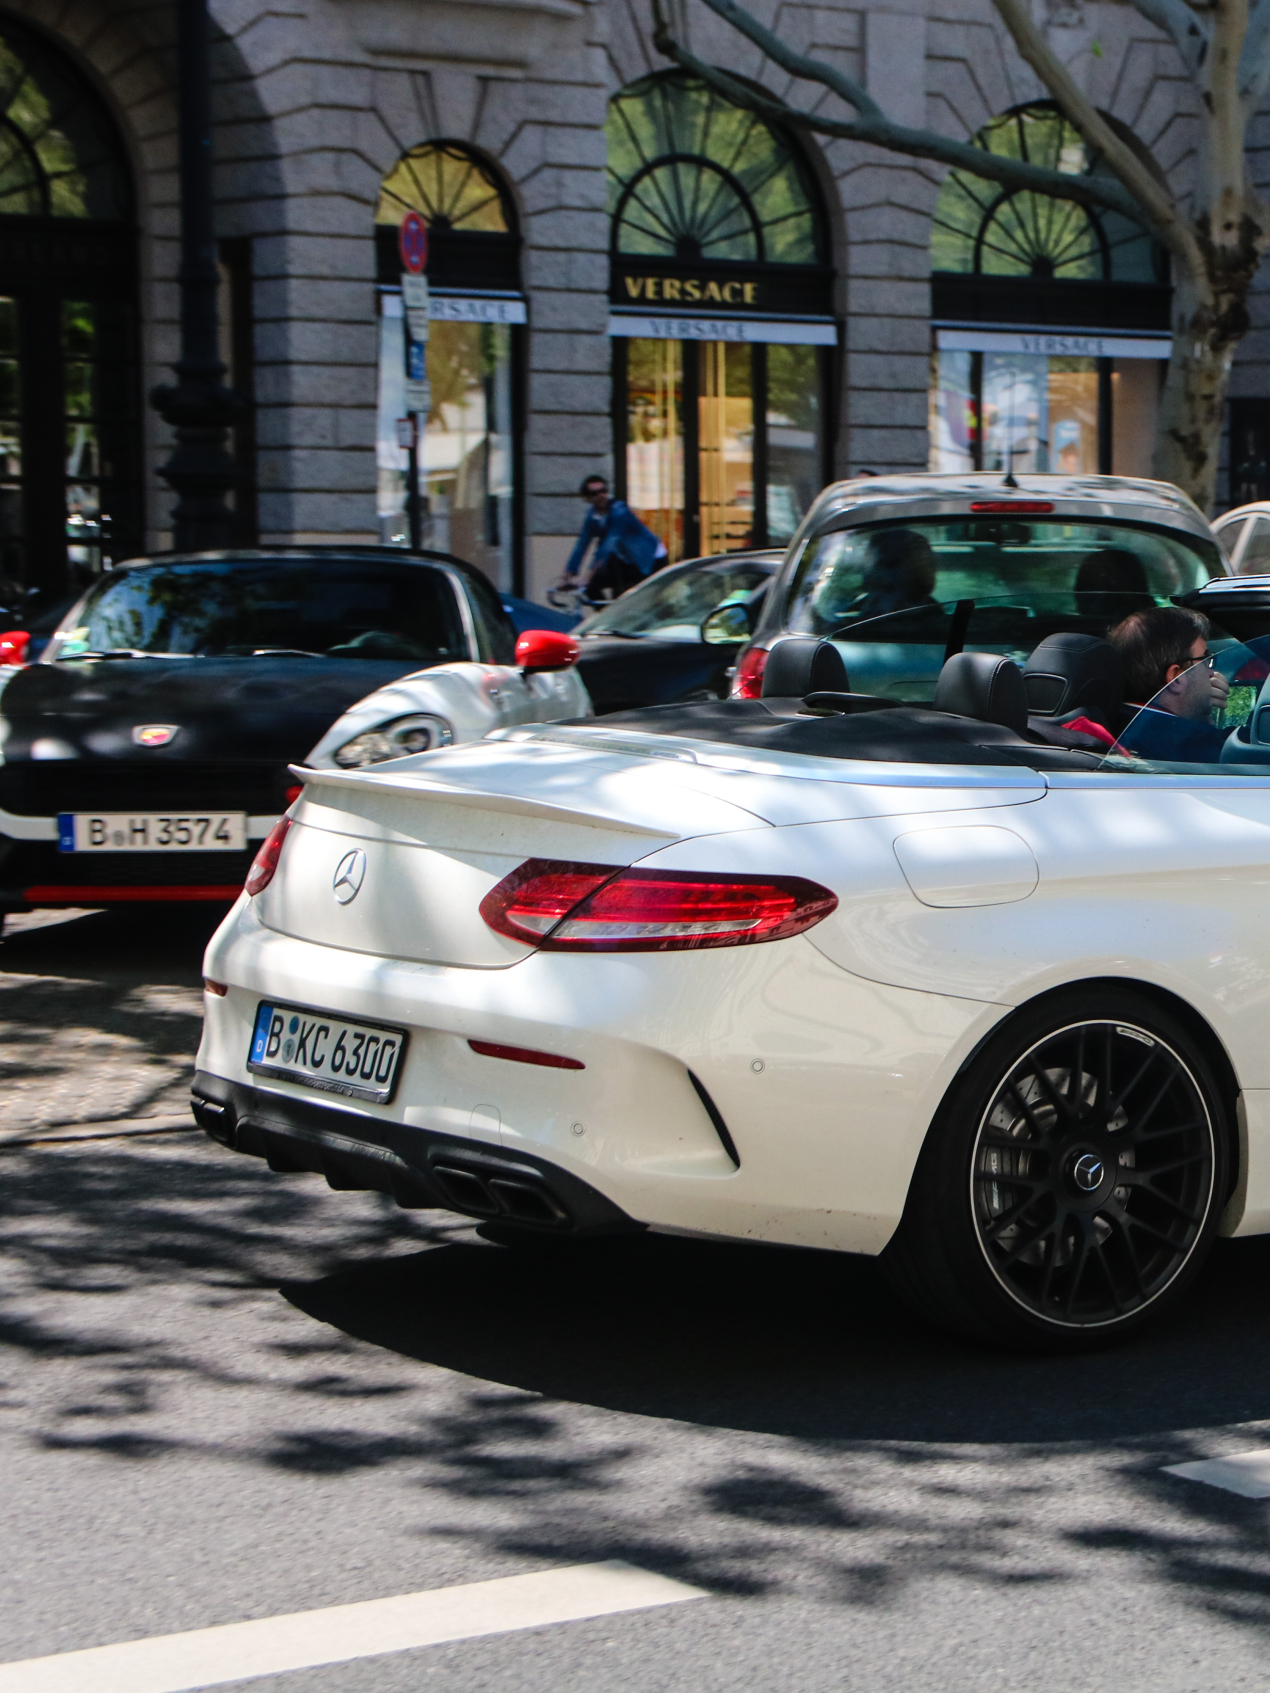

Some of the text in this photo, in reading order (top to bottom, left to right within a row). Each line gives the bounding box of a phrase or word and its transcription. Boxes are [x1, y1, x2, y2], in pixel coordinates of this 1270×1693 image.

[624, 276, 758, 305] VERSACE
[430, 301, 509, 320] RSACE
[650, 319, 746, 340] VERSACE
[1020, 336, 1104, 354] VERSACE
[88, 818, 233, 846] B H 3574
[256, 1040, 264, 1053] D
[265, 1014, 285, 1058] B
[294, 1020, 330, 1068] KC
[330, 1029, 396, 1083] 6300
